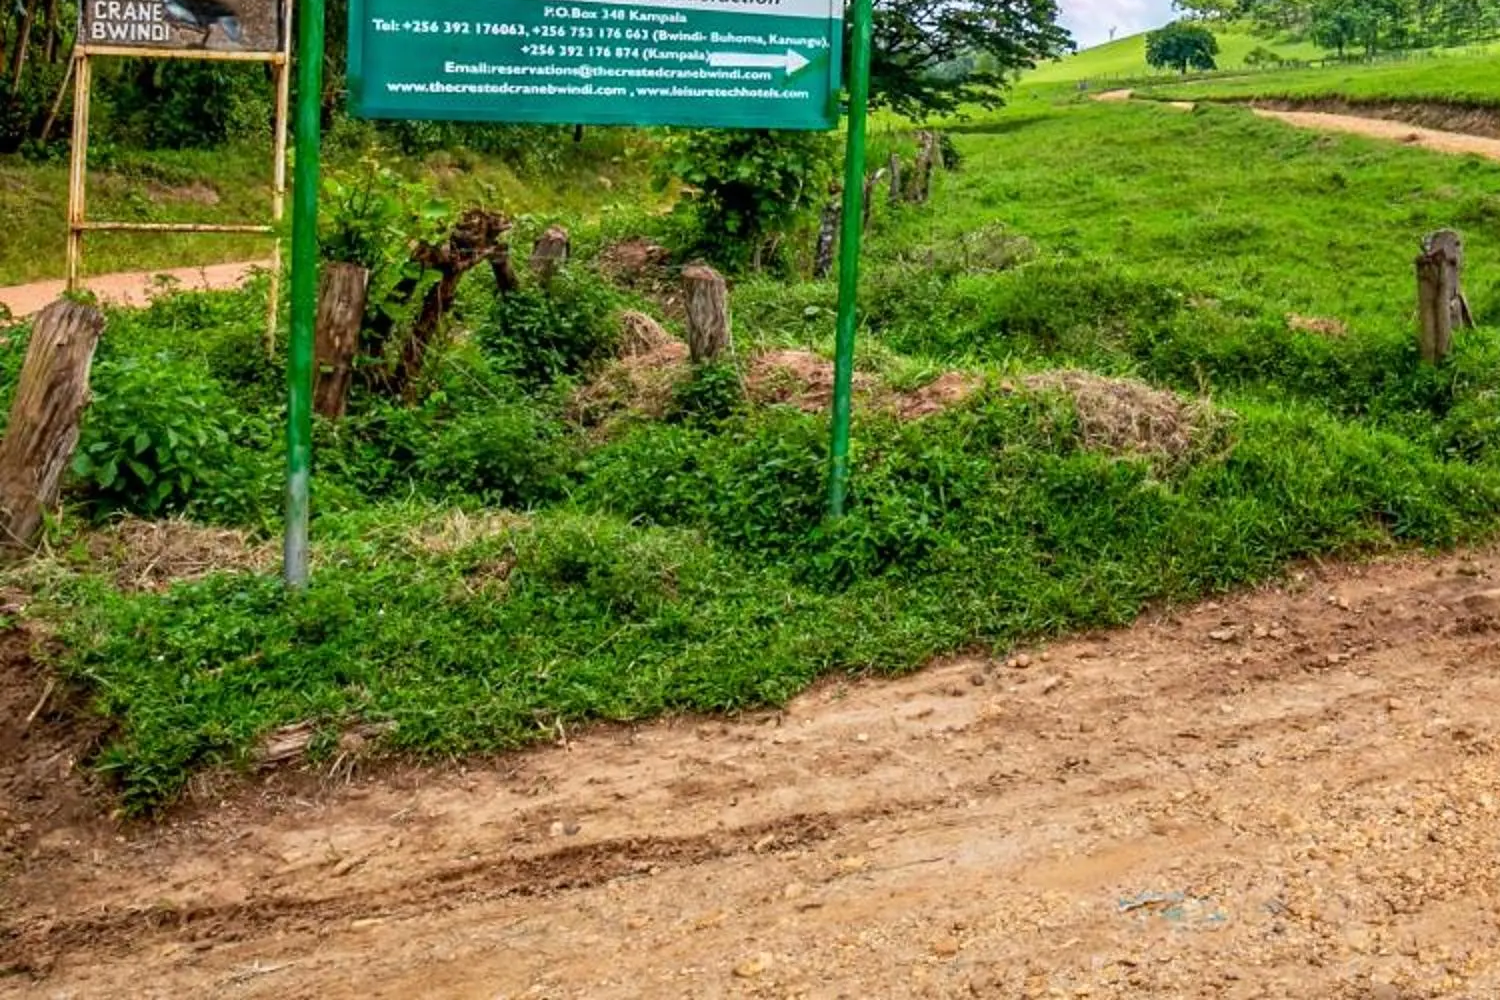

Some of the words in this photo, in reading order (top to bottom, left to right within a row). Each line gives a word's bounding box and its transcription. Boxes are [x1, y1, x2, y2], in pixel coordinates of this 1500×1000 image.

[95, 1, 162, 21] CRANE
[629, 11, 688, 26] Kampala
[92, 22, 169, 41] BWINDI
[372, 18, 400, 32] Tel:
[402, 20, 439, 33] +256
[444, 21, 470, 34] 392
[532, 25, 565, 37] +256
[599, 28, 622, 39] 176
[520, 44, 555, 56] +256
[559, 45, 584, 57] 392
[588, 46, 611, 57] 176
